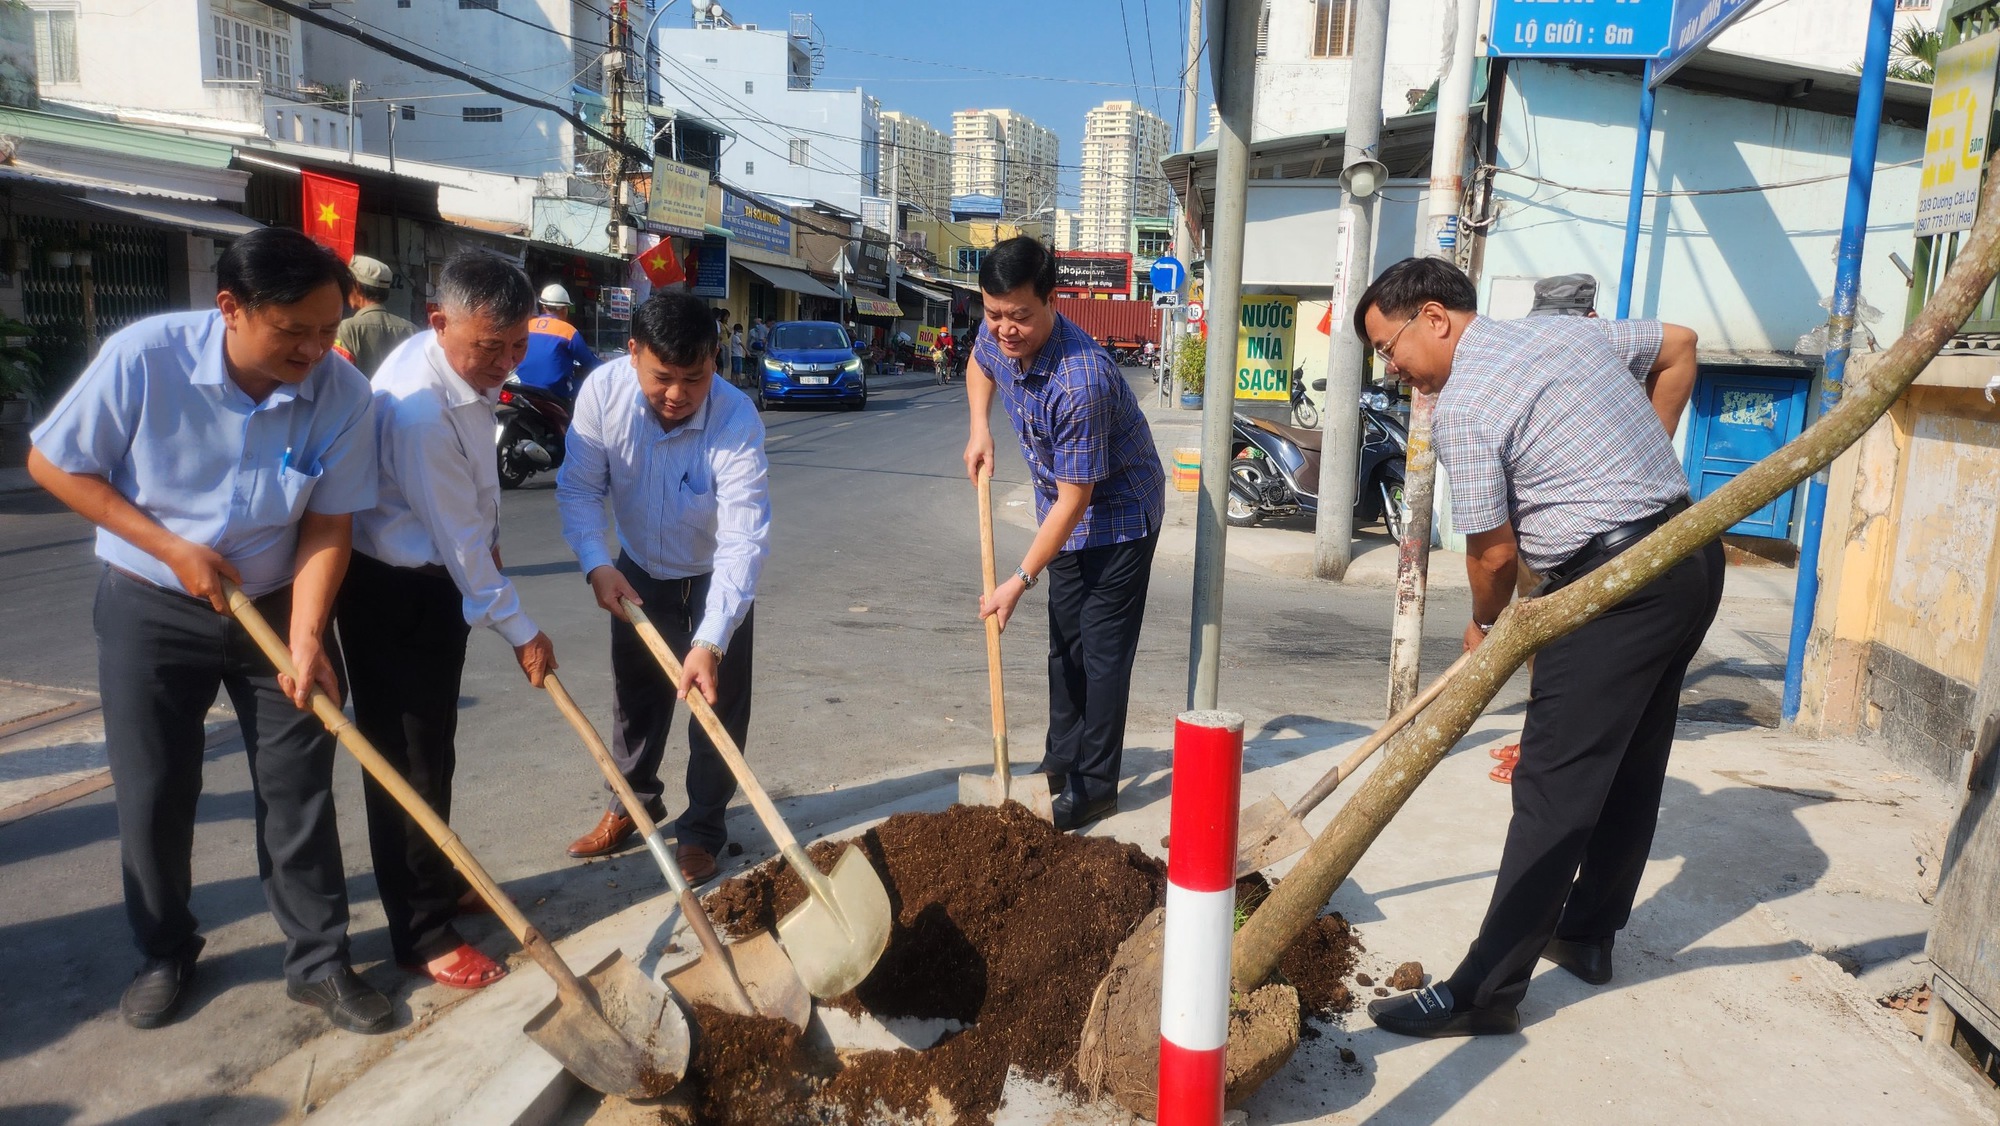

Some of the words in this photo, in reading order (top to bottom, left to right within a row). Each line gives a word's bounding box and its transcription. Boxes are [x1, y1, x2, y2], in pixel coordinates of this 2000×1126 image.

[1514, 19, 1538, 48] LỘ
[1544, 19, 1583, 44] GIỚI
[1604, 24, 1634, 45] 6m
[1918, 197, 1931, 213] 23/9
[1916, 217, 1931, 232] 0907
[1931, 214, 1943, 229] 776
[1944, 212, 1956, 227] 011
[1956, 209, 1974, 228] (Hoa)
[1189, 307, 1199, 318] 15
[1242, 300, 1293, 328] NƯỚC
[1247, 332, 1283, 360] MÍA
[1238, 368, 1288, 396] SẠCH
